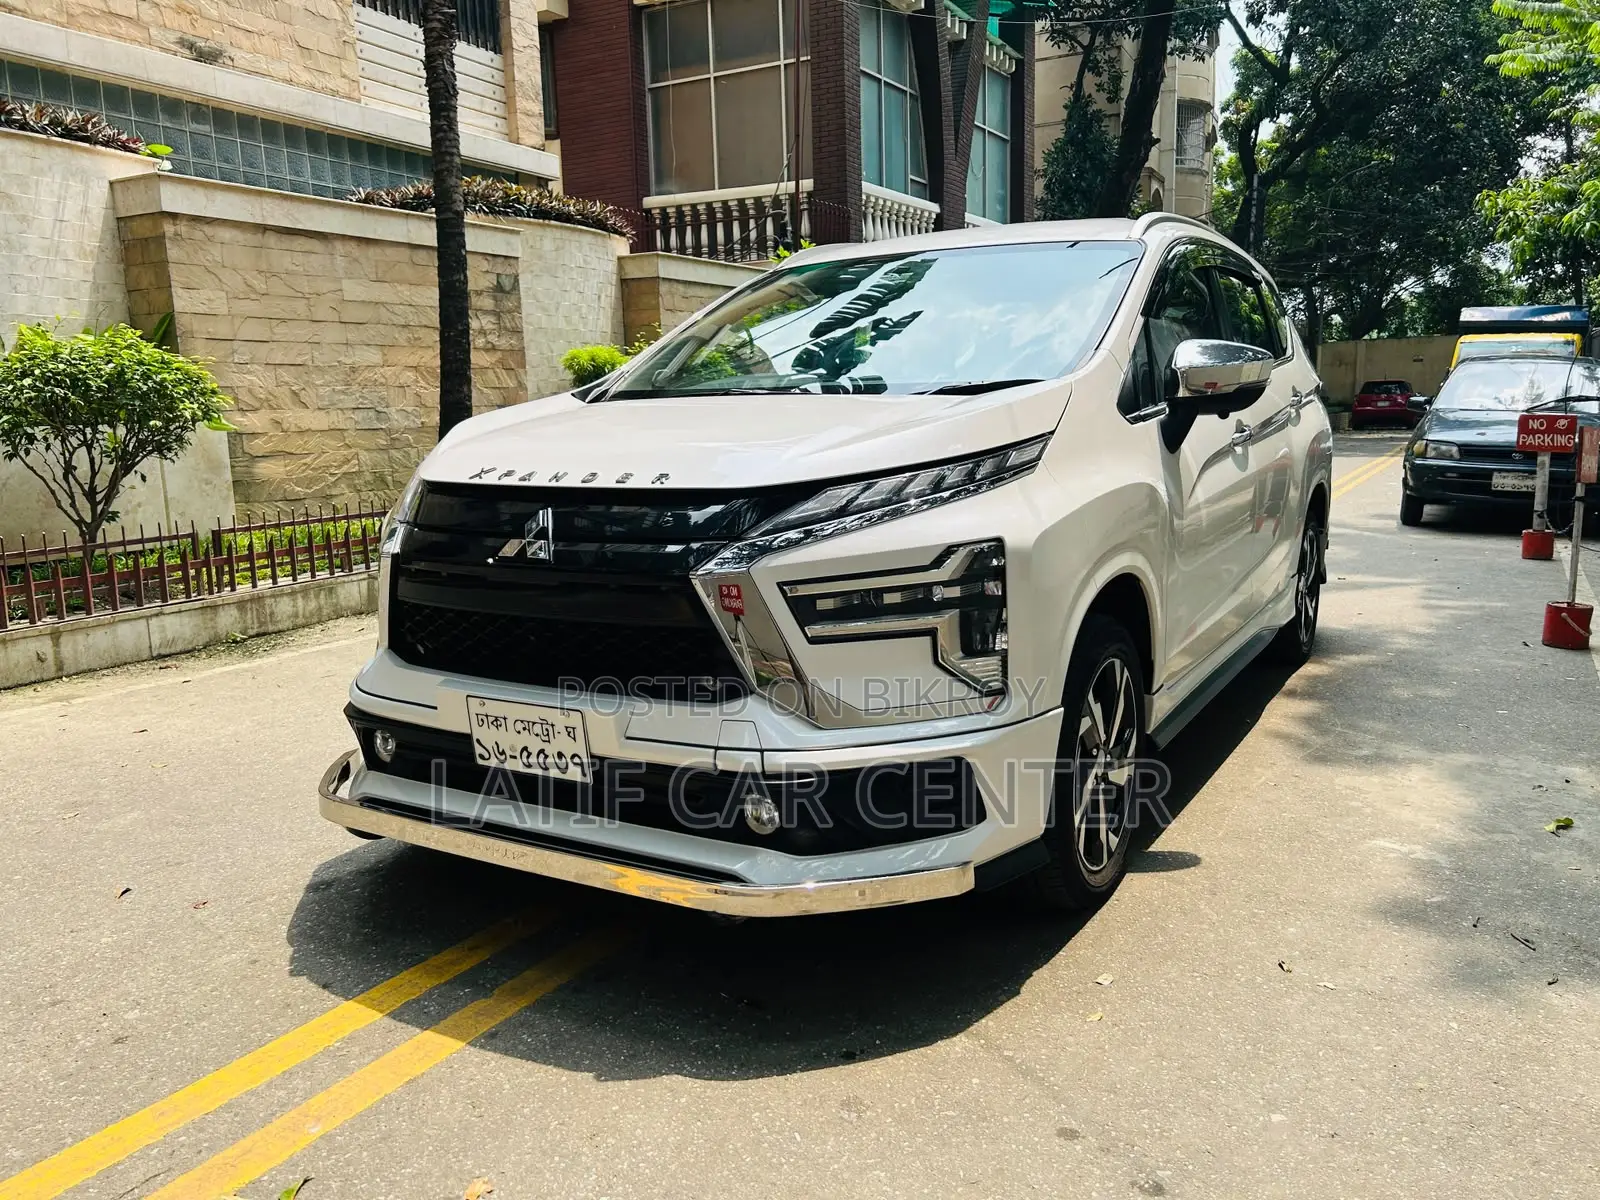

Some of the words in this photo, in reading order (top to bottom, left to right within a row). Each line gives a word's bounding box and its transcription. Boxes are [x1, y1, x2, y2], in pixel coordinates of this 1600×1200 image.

[1528, 418, 1547, 430] NO
[1519, 434, 1574, 447] PARKING
[468, 466, 671, 485] XPANDER
[475, 712, 509, 733] ঢাকা
[475, 738, 587, 778] ১৬-৫৫৩৭
